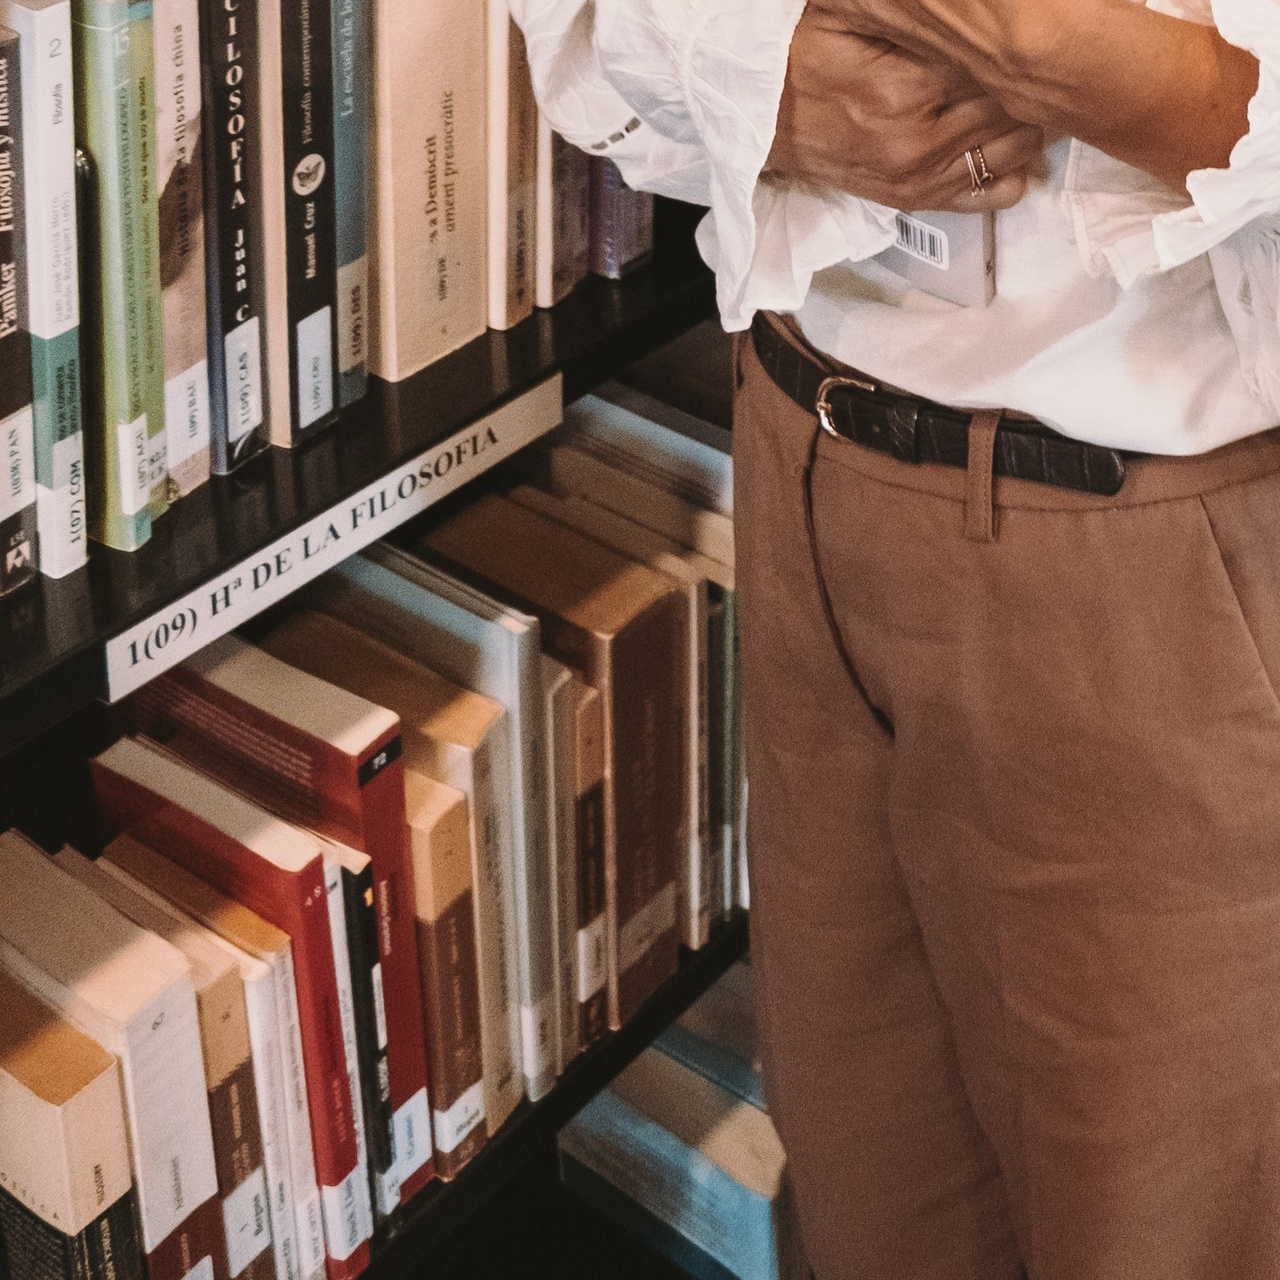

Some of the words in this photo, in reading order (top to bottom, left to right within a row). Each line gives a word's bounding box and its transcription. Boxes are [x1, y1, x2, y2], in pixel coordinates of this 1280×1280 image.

[49, 38, 62, 58] 2
[172, 24, 184, 67] china
[340, 18, 354, 37] de
[173, 74, 186, 142] filosofía
[339, 96, 354, 117] La
[441, 90, 458, 177] presocràtic
[423, 134, 438, 214] Demòcrit
[304, 201, 316, 230] Cruz
[305, 234, 317, 279] Manuel
[6, 427, 21, 458] PAN
[68, 459, 82, 497] COM
[69, 501, 84, 545] 1(07)
[127, 602, 198, 670] 1(09)
[211, 573, 244, 615] Hª
[252, 545, 293, 592] DE
[302, 521, 342, 560] LA
[349, 424, 499, 529] FILOSOFIA
